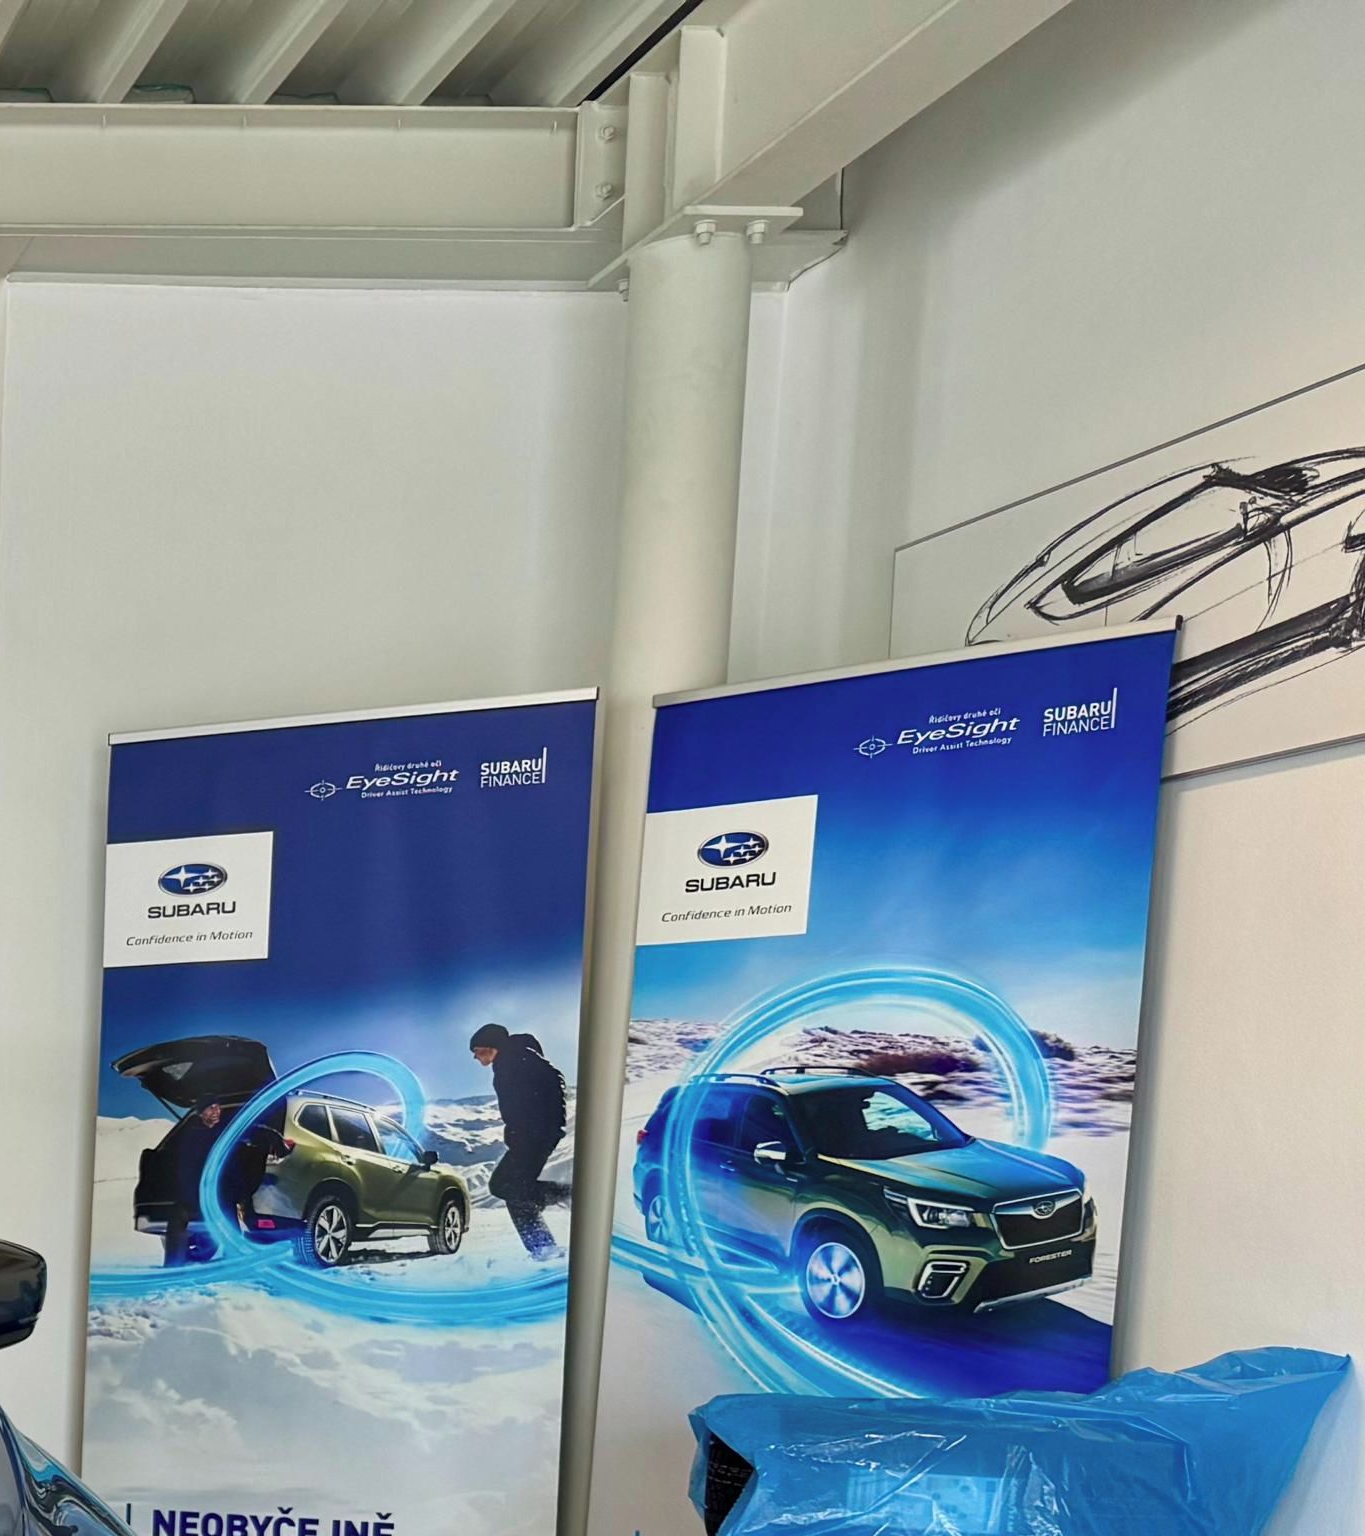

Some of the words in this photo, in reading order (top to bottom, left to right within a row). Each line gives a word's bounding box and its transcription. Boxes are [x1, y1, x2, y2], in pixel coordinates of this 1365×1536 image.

[1043, 700, 1112, 723] SUBARU
[896, 717, 1021, 746] EyeSight
[1043, 715, 1110, 737] FINANCE
[912, 745, 938, 755] Driver
[940, 741, 963, 751] Assist
[966, 737, 1013, 748] Technology
[480, 757, 542, 776] SUBARU
[346, 769, 460, 791] EyeSight
[480, 771, 542, 789] FINANCE
[361, 791, 384, 799] Driver
[385, 789, 409, 797] Assist
[410, 786, 453, 795] Technology
[684, 871, 777, 893] SUBARU
[147, 900, 237, 919] SUBARU
[661, 909, 732, 923] Confidence
[734, 907, 745, 916] in
[747, 904, 792, 915] Motion
[126, 934, 194, 946] Confidence
[195, 931, 207, 942] in
[209, 929, 253, 941] Motion
[1029, 1249, 1073, 1264] FORESTER
